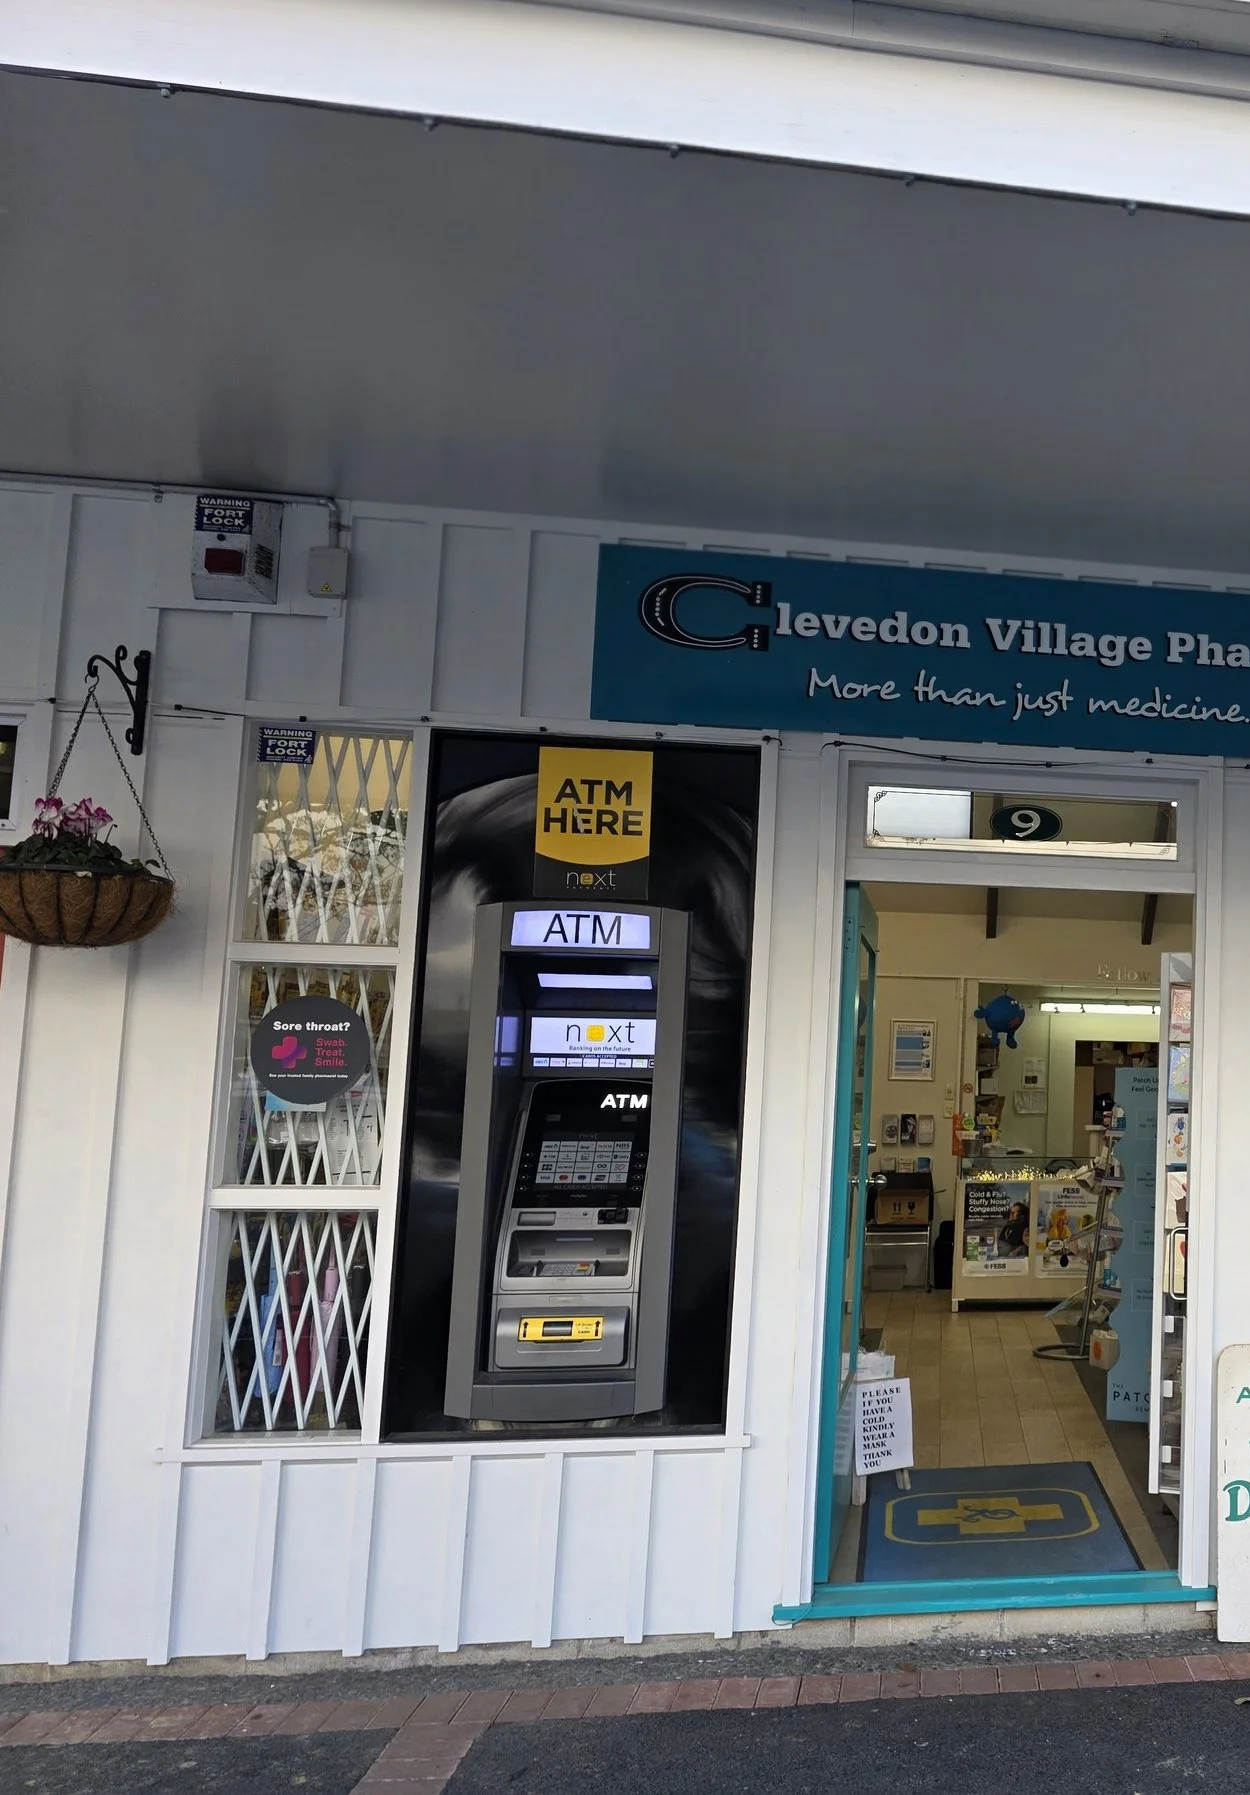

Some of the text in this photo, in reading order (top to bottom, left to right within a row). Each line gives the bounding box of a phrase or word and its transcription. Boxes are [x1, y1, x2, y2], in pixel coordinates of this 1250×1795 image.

[199, 497, 251, 507] WARNING
[204, 508, 246, 518] FORT
[203, 517, 245, 527] LOCK
[638, 573, 972, 652] Clevedon
[985, 617, 1153, 668] Village
[808, 667, 901, 701] More
[914, 669, 1006, 707] than
[1013, 679, 1074, 721] just
[263, 728, 313, 738] WARNING
[267, 739, 308, 748] FORT
[266, 747, 308, 757] LOCK
[553, 778, 633, 806] ATM
[543, 807, 644, 837] HERE
[1010, 809, 1042, 838] 9
[566, 870, 617, 887] next
[543, 913, 622, 945] ATM
[272, 1021, 351, 1031] Sore throat?
[566, 1021, 635, 1043] nxt
[316, 1037, 348, 1047] Swab.
[315, 1048, 345, 1057] Treat.
[568, 1045, 593, 1053] Banking
[314, 1057, 348, 1067] Smile.
[1133, 1076, 1152, 1084] Patch
[1131, 1085, 1159, 1093] Feel Goo
[600, 1093, 648, 1109] ATM
[1062, 1187, 1080, 1195] FESS
[862, 1386, 902, 1399] PLEASE
[1112, 1390, 1150, 1403] PATC
[862, 1397, 894, 1408] IF YOU
[862, 1406, 893, 1417] HAVE A
[862, 1416, 885, 1425] COLD
[862, 1422, 895, 1433] KINDLY
[862, 1433, 889, 1442] WEAR
[862, 1441, 887, 1450] MASK
[863, 1450, 893, 1461] THANK
[863, 1460, 882, 1469] YOU
